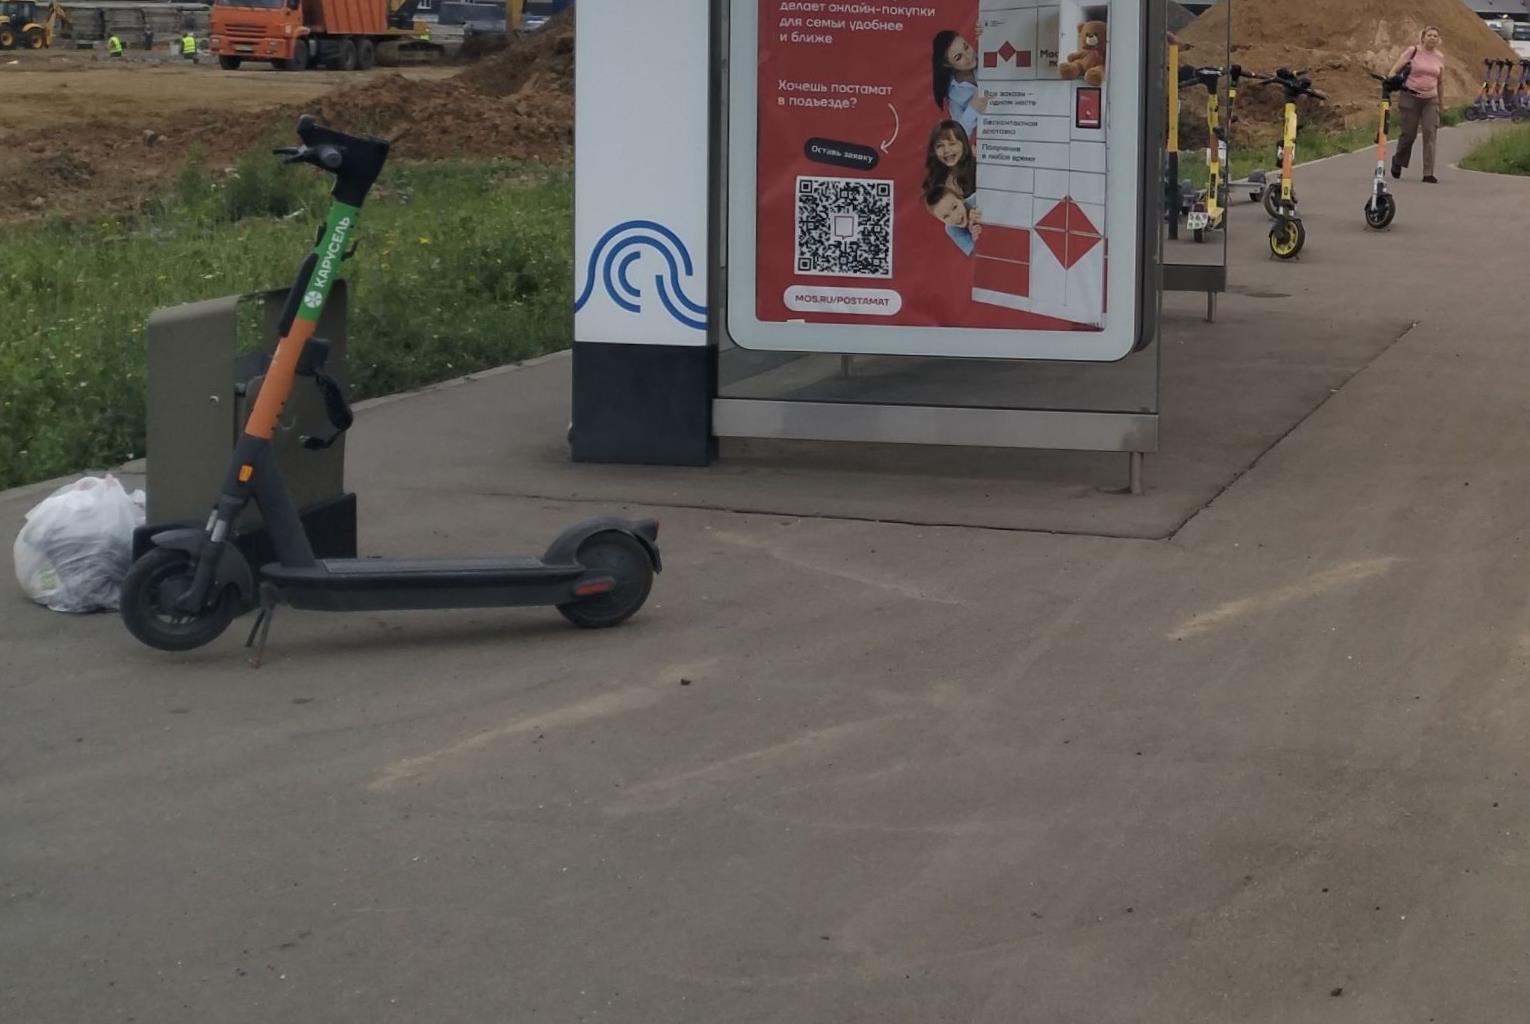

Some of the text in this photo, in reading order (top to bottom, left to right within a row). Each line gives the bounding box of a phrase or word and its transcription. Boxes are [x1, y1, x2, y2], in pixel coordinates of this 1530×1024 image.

[779, 1, 936, 18] делает онлайн-покупки
[779, 17, 904, 33] для семьи удобнее
[779, 31, 833, 44] и ближе
[778, 79, 893, 95] Хочешь постамат
[777, 95, 858, 109] в подъезде?
[810, 144, 874, 164] Оставь заявку
[313, 216, 350, 289] КАРУСЕЛЬ
[794, 293, 890, 307] MOS.RU/POSTAMAT
